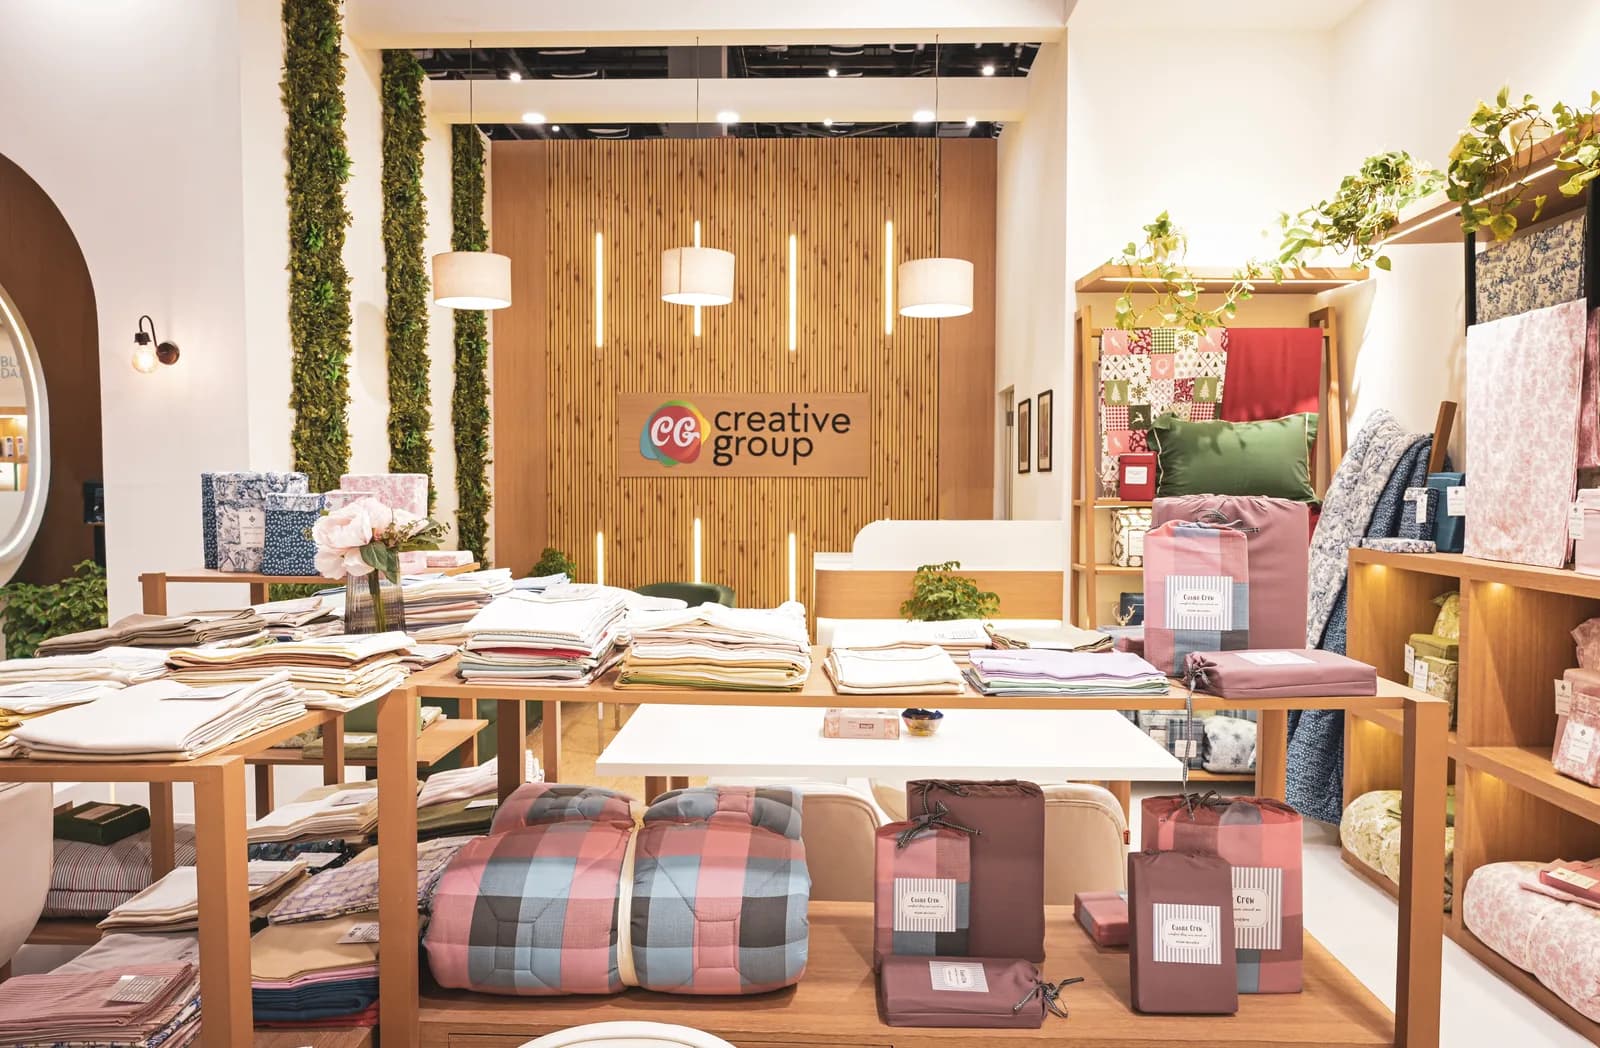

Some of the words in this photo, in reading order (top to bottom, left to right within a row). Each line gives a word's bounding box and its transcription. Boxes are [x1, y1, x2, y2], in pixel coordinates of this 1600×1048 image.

[651, 415, 700, 448] CG
[714, 402, 851, 433] creative
[712, 434, 814, 466] group
[1236, 895, 1255, 904] Crew
